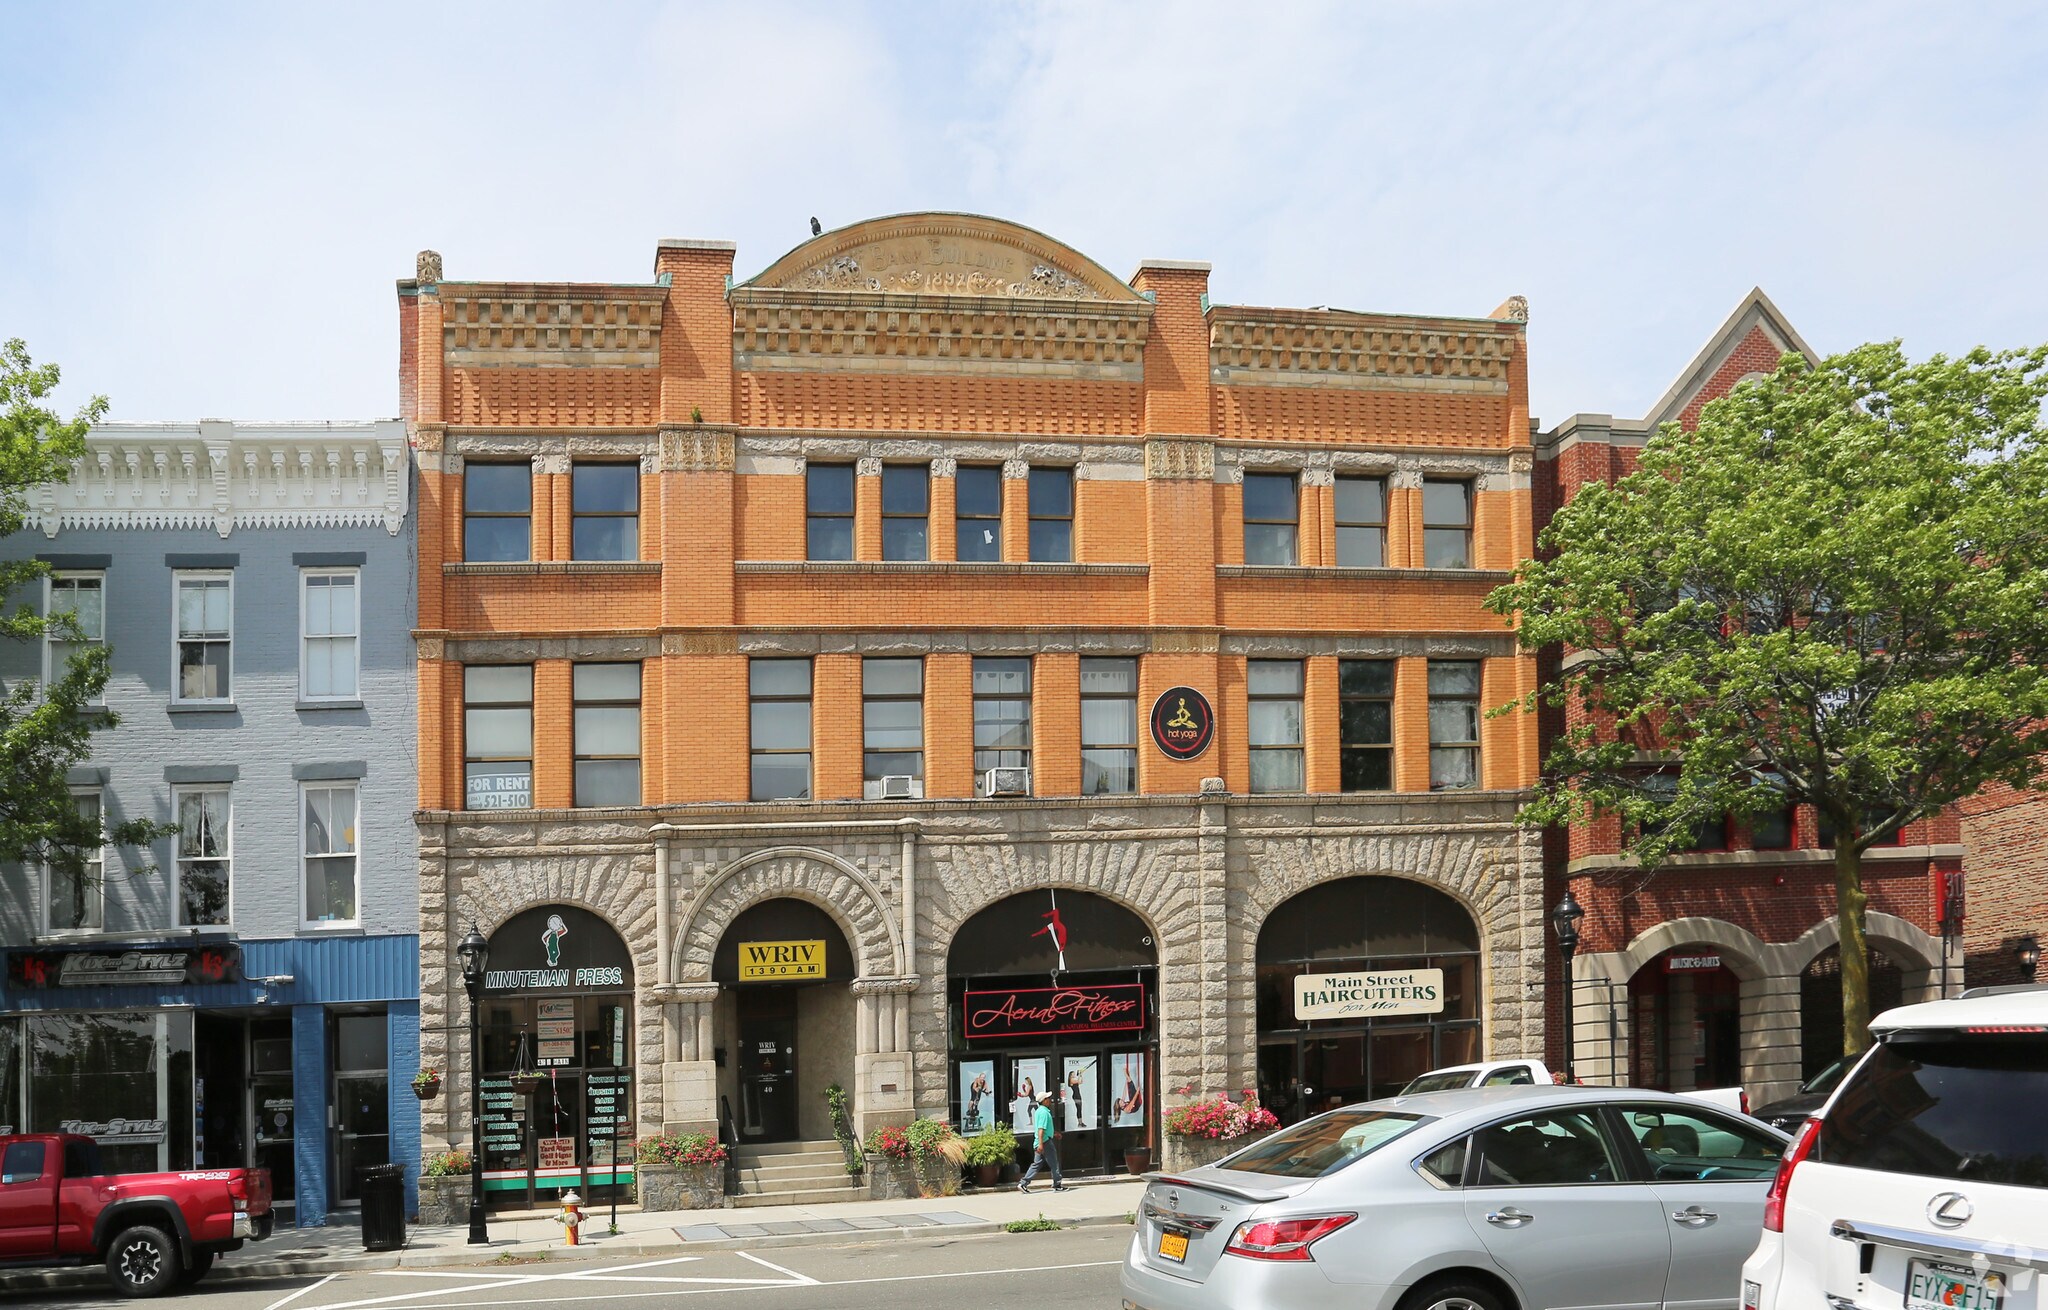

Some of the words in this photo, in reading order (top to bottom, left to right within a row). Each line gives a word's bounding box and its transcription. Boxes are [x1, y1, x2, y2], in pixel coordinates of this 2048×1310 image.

[924, 238, 1014, 274] BUILDING
[926, 271, 965, 289] 1892
[1168, 730, 1180, 738] hot
[1181, 730, 1198, 739] yoga
[468, 778, 491, 792] FOR
[496, 776, 530, 791] RENT
[748, 944, 817, 963] WRIV
[118, 952, 187, 972] STYLZ
[750, 966, 787, 975] 1390
[796, 965, 816, 973] AM
[486, 969, 569, 988] MINUTEMAN
[575, 967, 622, 986] PRESS
[1325, 977, 1362, 988] Main
[1366, 975, 1414, 987] Street
[1303, 985, 1437, 1007] HAIRCUTTERS
[972, 990, 1068, 1028] Aerial
[1054, 990, 1137, 1023] Fitness
[1338, 1002, 1364, 1014] for
[1365, 1000, 1400, 1011] Men
[588, 1088, 625, 1096] BUSINES
[105, 1118, 164, 1135] STYLZ
[588, 1116, 627, 1124] ENVELOES
[178, 1173, 205, 1181] TRD
[1937, 1264, 1966, 1273] LEXUS
[1912, 1274, 1943, 1301] EYX
